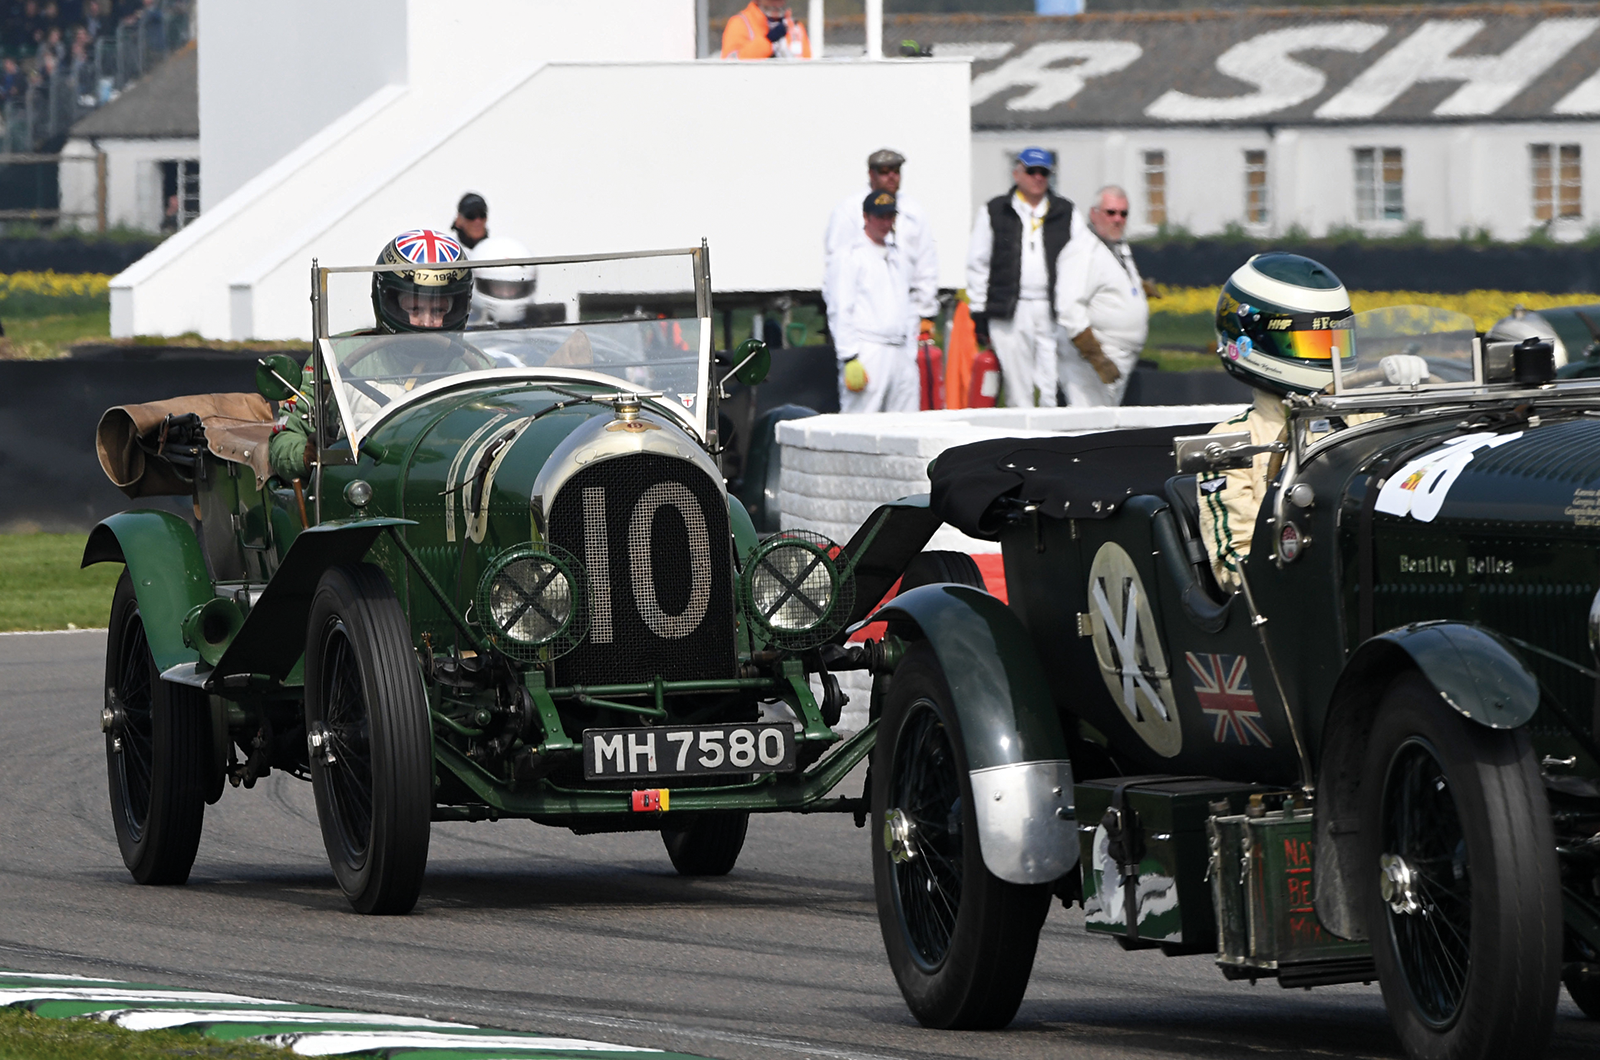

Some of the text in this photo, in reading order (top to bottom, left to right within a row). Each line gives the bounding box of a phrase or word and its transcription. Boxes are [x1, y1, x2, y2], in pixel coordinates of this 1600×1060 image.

[1142, 17, 1600, 122] SH
[582, 481, 712, 643] 10
[1400, 555, 1514, 577] Bentley Belles
[593, 727, 785, 774] MH 7580
